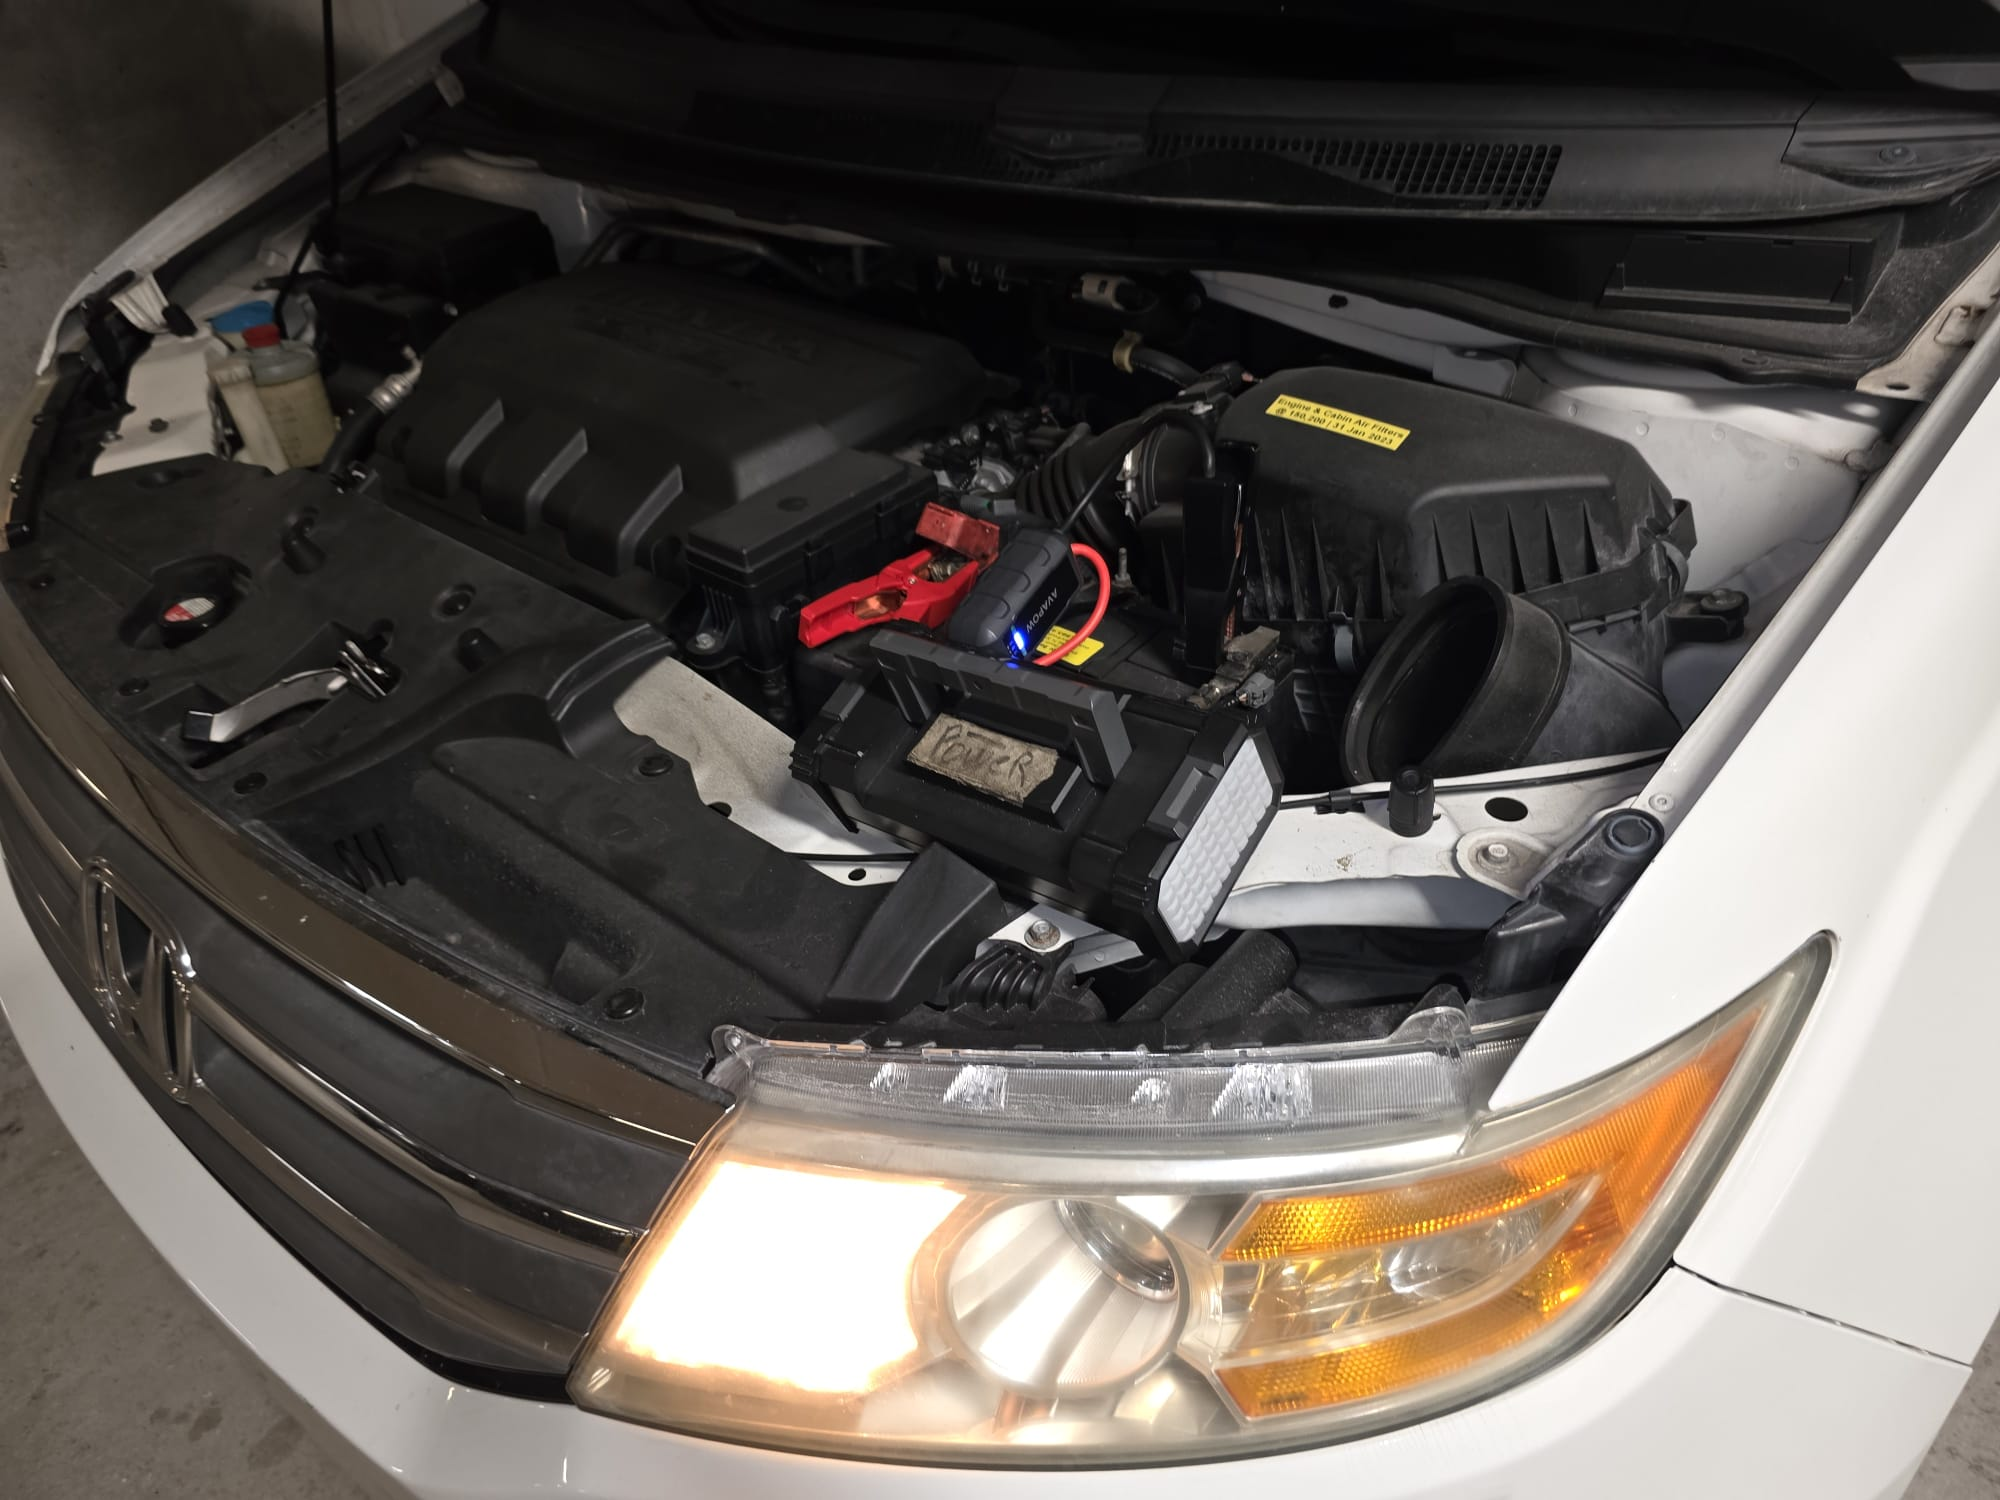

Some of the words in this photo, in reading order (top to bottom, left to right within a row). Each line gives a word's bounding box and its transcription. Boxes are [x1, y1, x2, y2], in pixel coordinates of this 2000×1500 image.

[1275, 407, 1286, 416] @
[1346, 427, 1366, 437] Jan
[1368, 431, 1394, 445] 2023
[1277, 398, 1311, 411] Engine
[1323, 410, 1352, 423] Cabin
[1354, 419, 1369, 428] Air
[1371, 423, 1404, 438] Filters
[1026, 587, 1058, 633] AVAPOW
